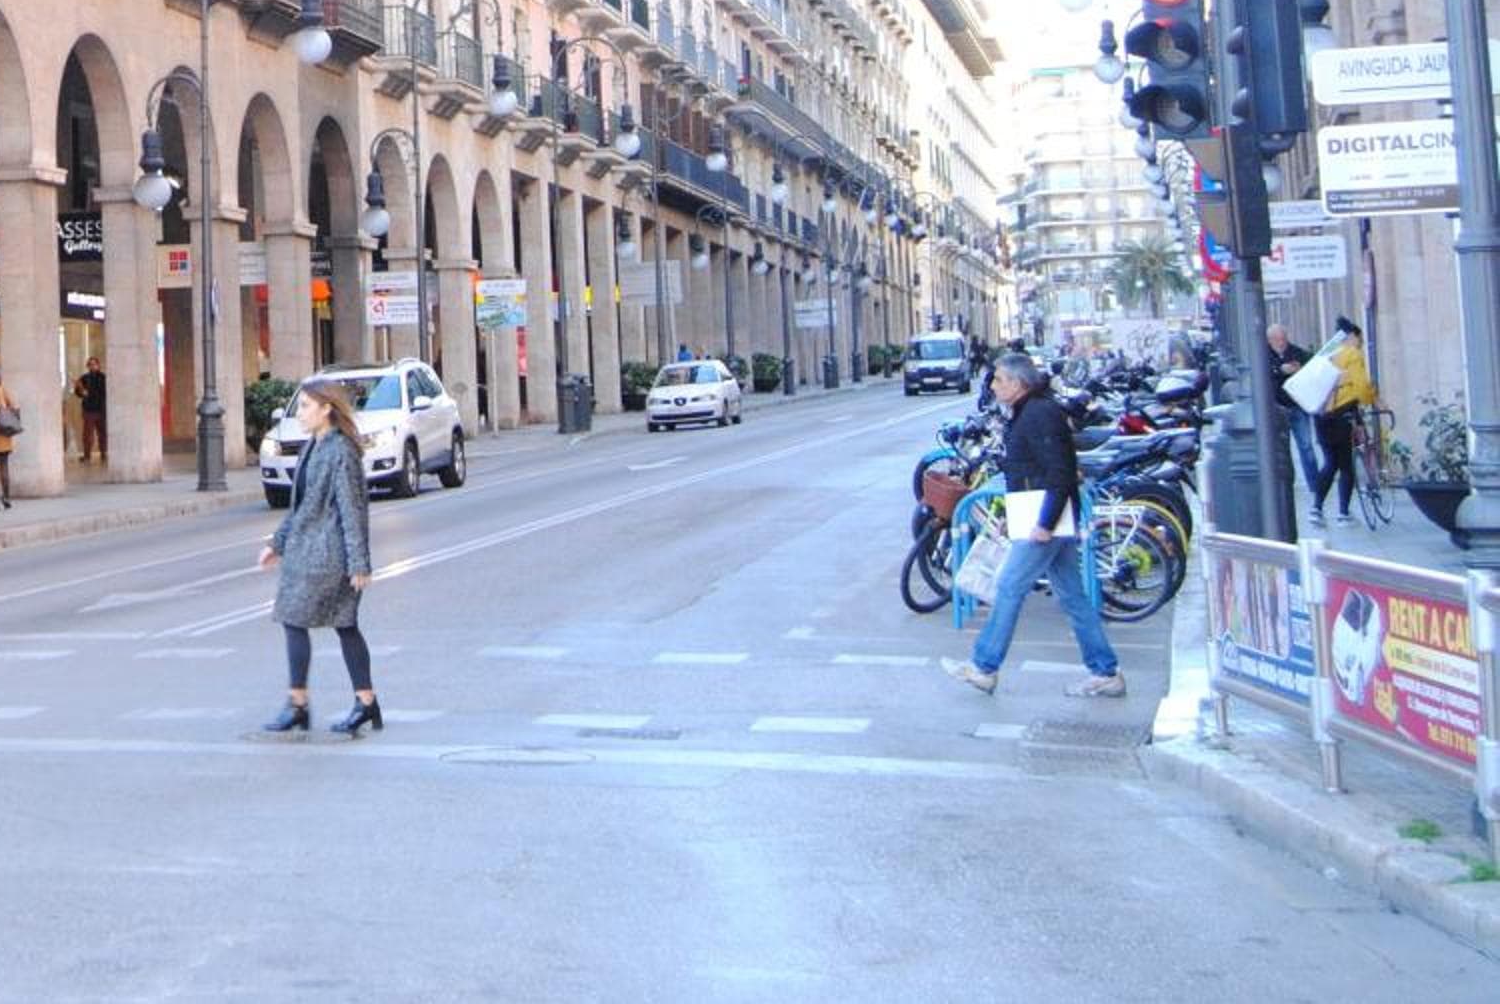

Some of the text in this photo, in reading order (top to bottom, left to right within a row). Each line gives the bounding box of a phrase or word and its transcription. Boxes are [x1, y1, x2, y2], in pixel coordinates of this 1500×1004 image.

[1339, 56, 1412, 77] AVINGUDA
[1388, 597, 1426, 642] RENT
[1429, 607, 1442, 647] A
